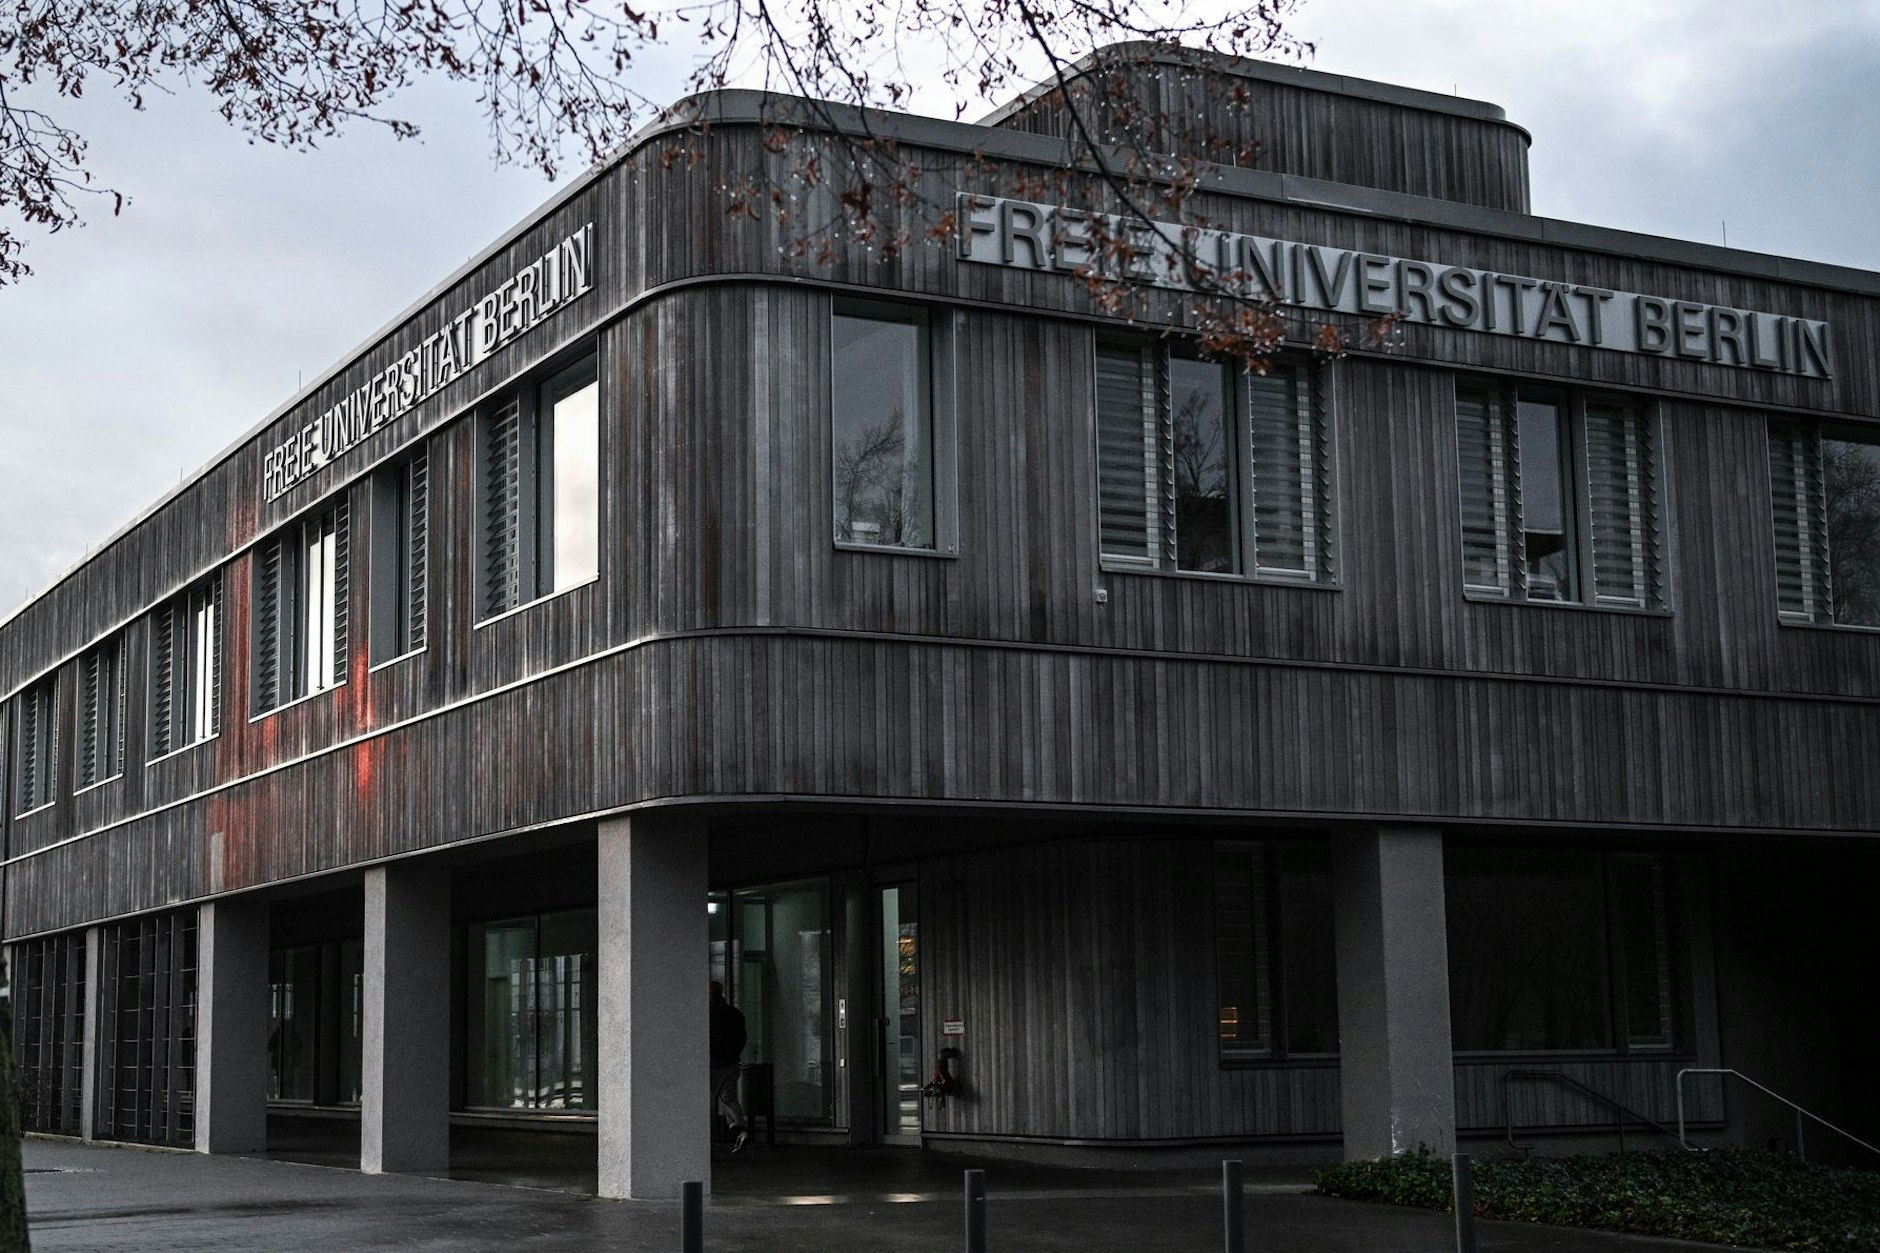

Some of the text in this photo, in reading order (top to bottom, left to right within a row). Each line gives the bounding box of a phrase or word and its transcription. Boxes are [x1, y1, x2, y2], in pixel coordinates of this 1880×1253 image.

[264, 225, 591, 501] FREIE UNIVERSITÄT BERLIN
[1635, 295, 1830, 377] BERLIN
